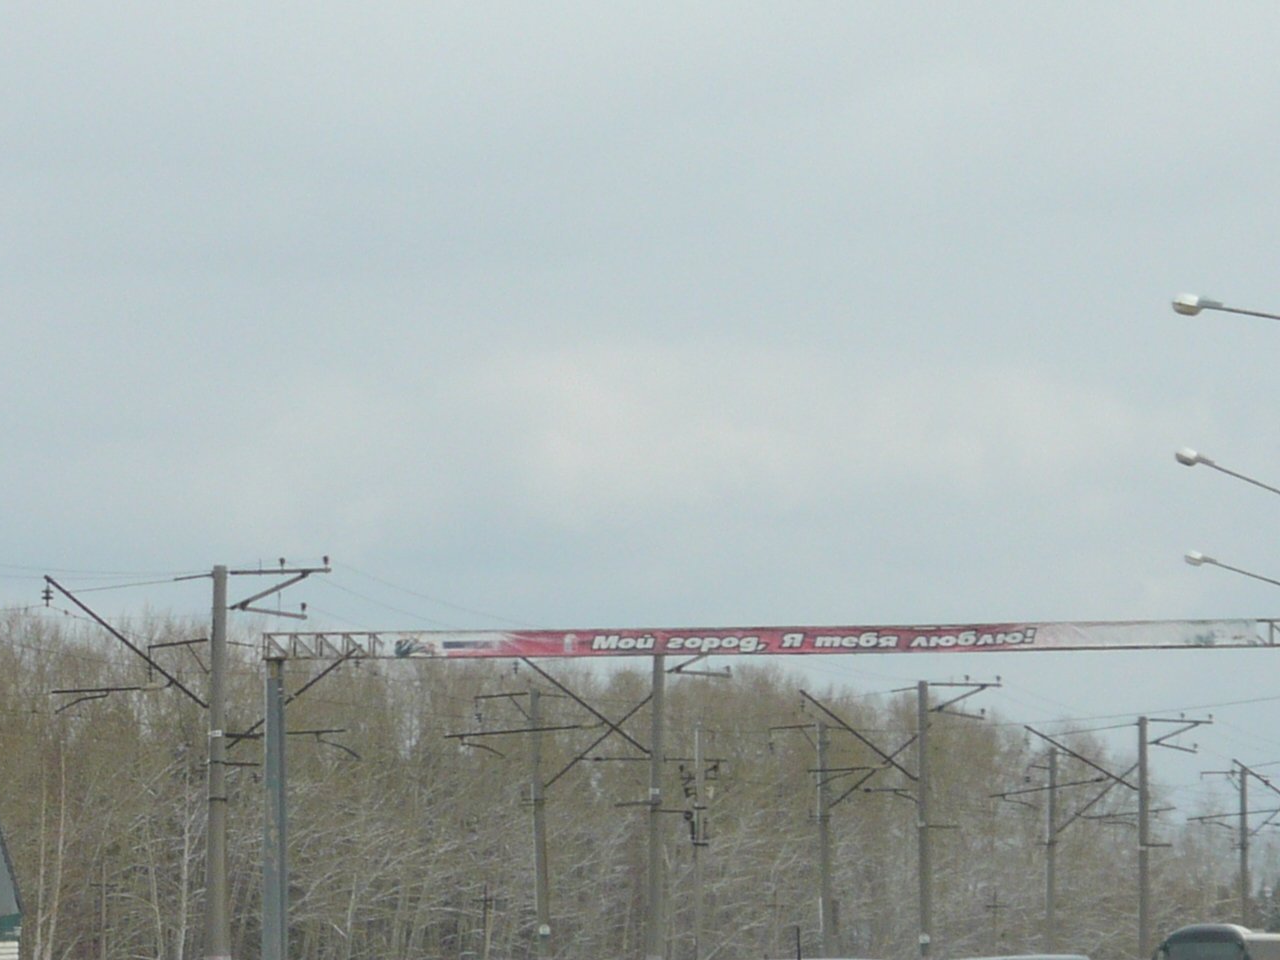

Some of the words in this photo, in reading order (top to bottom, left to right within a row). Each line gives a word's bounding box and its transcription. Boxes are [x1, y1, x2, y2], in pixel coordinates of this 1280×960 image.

[592, 634, 656, 650] Мой
[667, 635, 767, 652] город,
[782, 633, 804, 648] Я
[815, 632, 898, 648] тебя
[910, 627, 1037, 648] люблю!
